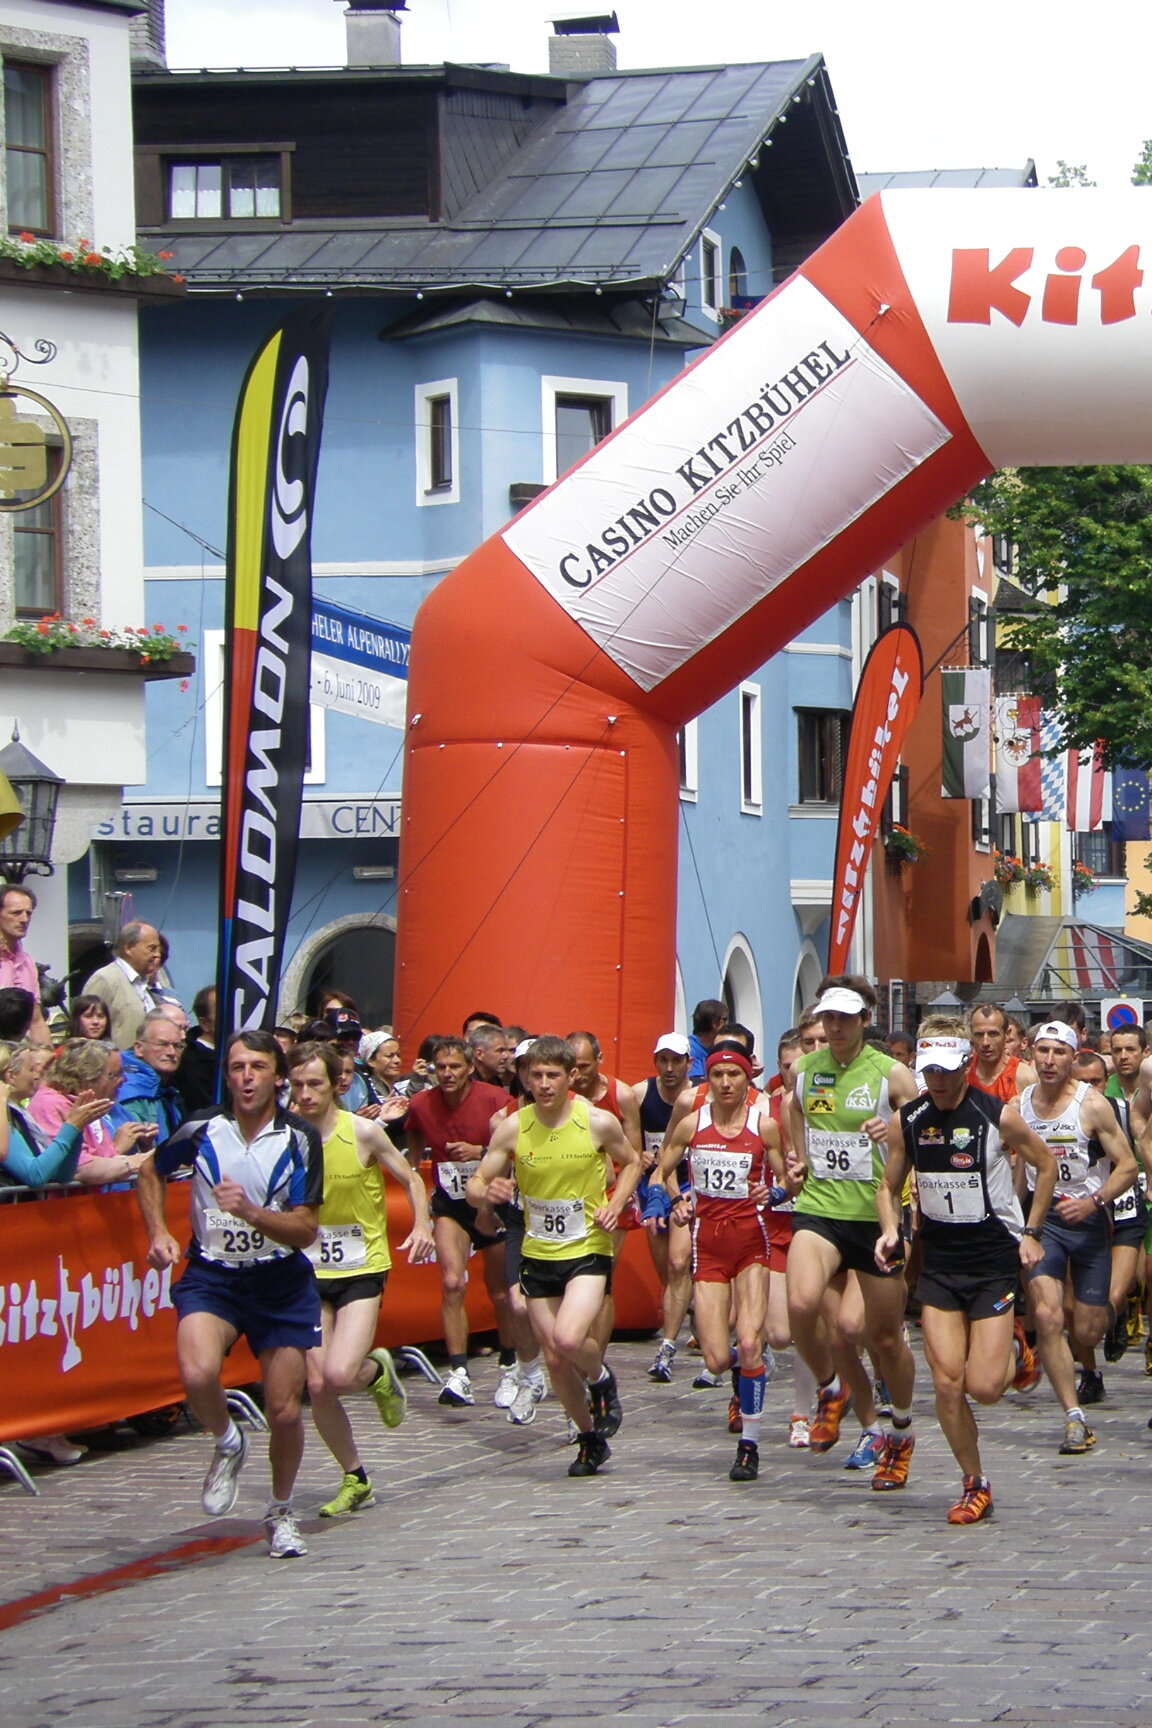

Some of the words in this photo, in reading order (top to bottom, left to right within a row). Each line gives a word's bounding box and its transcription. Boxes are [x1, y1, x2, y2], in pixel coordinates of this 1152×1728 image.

[559, 487, 677, 588] CASINO
[675, 340, 851, 495] KITZBÜHEL
[662, 502, 718, 551] Machen
[715, 481, 741, 506] Sie
[737, 461, 763, 489] Ihr
[759, 431, 797, 469] Spiel
[334, 673, 356, 702] Juni
[357, 682, 381, 709] 2009
[234, 576, 293, 1032] SALOMON
[848, 1096, 878, 1110] KSV
[811, 1134, 857, 1148] Sparkasse
[693, 1154, 737, 1168] Sparkasse
[826, 1149, 850, 1171] 96
[451, 1175, 468, 1193] 15
[703, 1167, 736, 1191] 132
[919, 1178, 966, 1190] Sparkasse
[528, 1202, 571, 1214] Sparkasse
[943, 1191, 954, 1214] 1
[543, 1215, 566, 1234] 56
[223, 1229, 265, 1253] 239
[320, 1240, 344, 1264] 55
